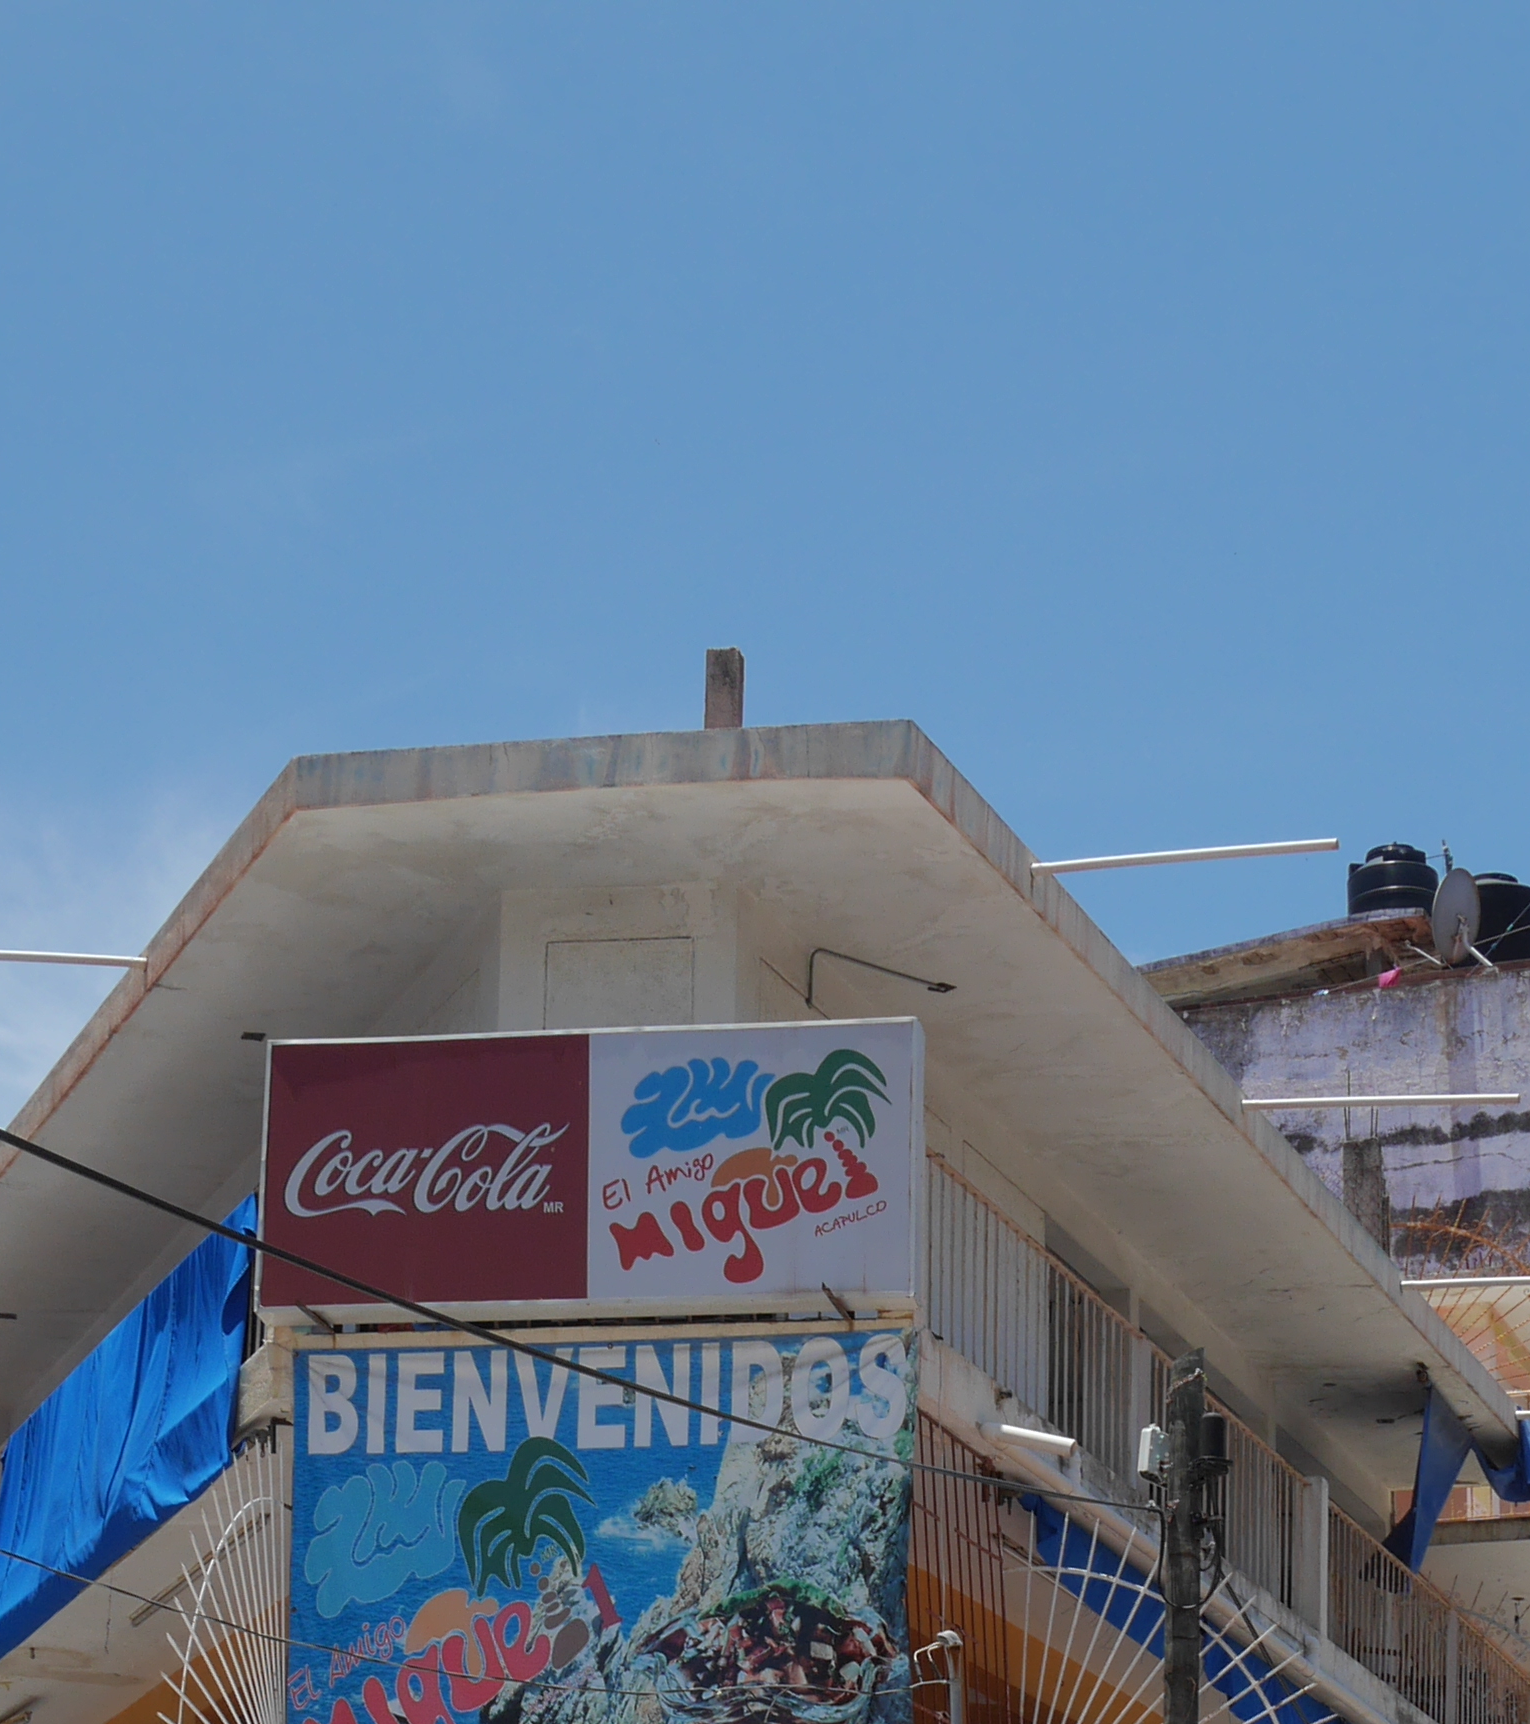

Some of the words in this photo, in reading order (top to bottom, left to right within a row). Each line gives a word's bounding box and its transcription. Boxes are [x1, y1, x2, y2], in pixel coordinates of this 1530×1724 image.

[284, 1122, 570, 1218] Coca-Cola
[602, 1179, 631, 1210] El
[645, 1153, 714, 1194] Amigo
[543, 1201, 564, 1214] MR
[814, 1200, 887, 1237] ACAPULCO
[308, 1334, 906, 1455] BIENVENIDOS
[329, 1616, 406, 1687] Amigo
